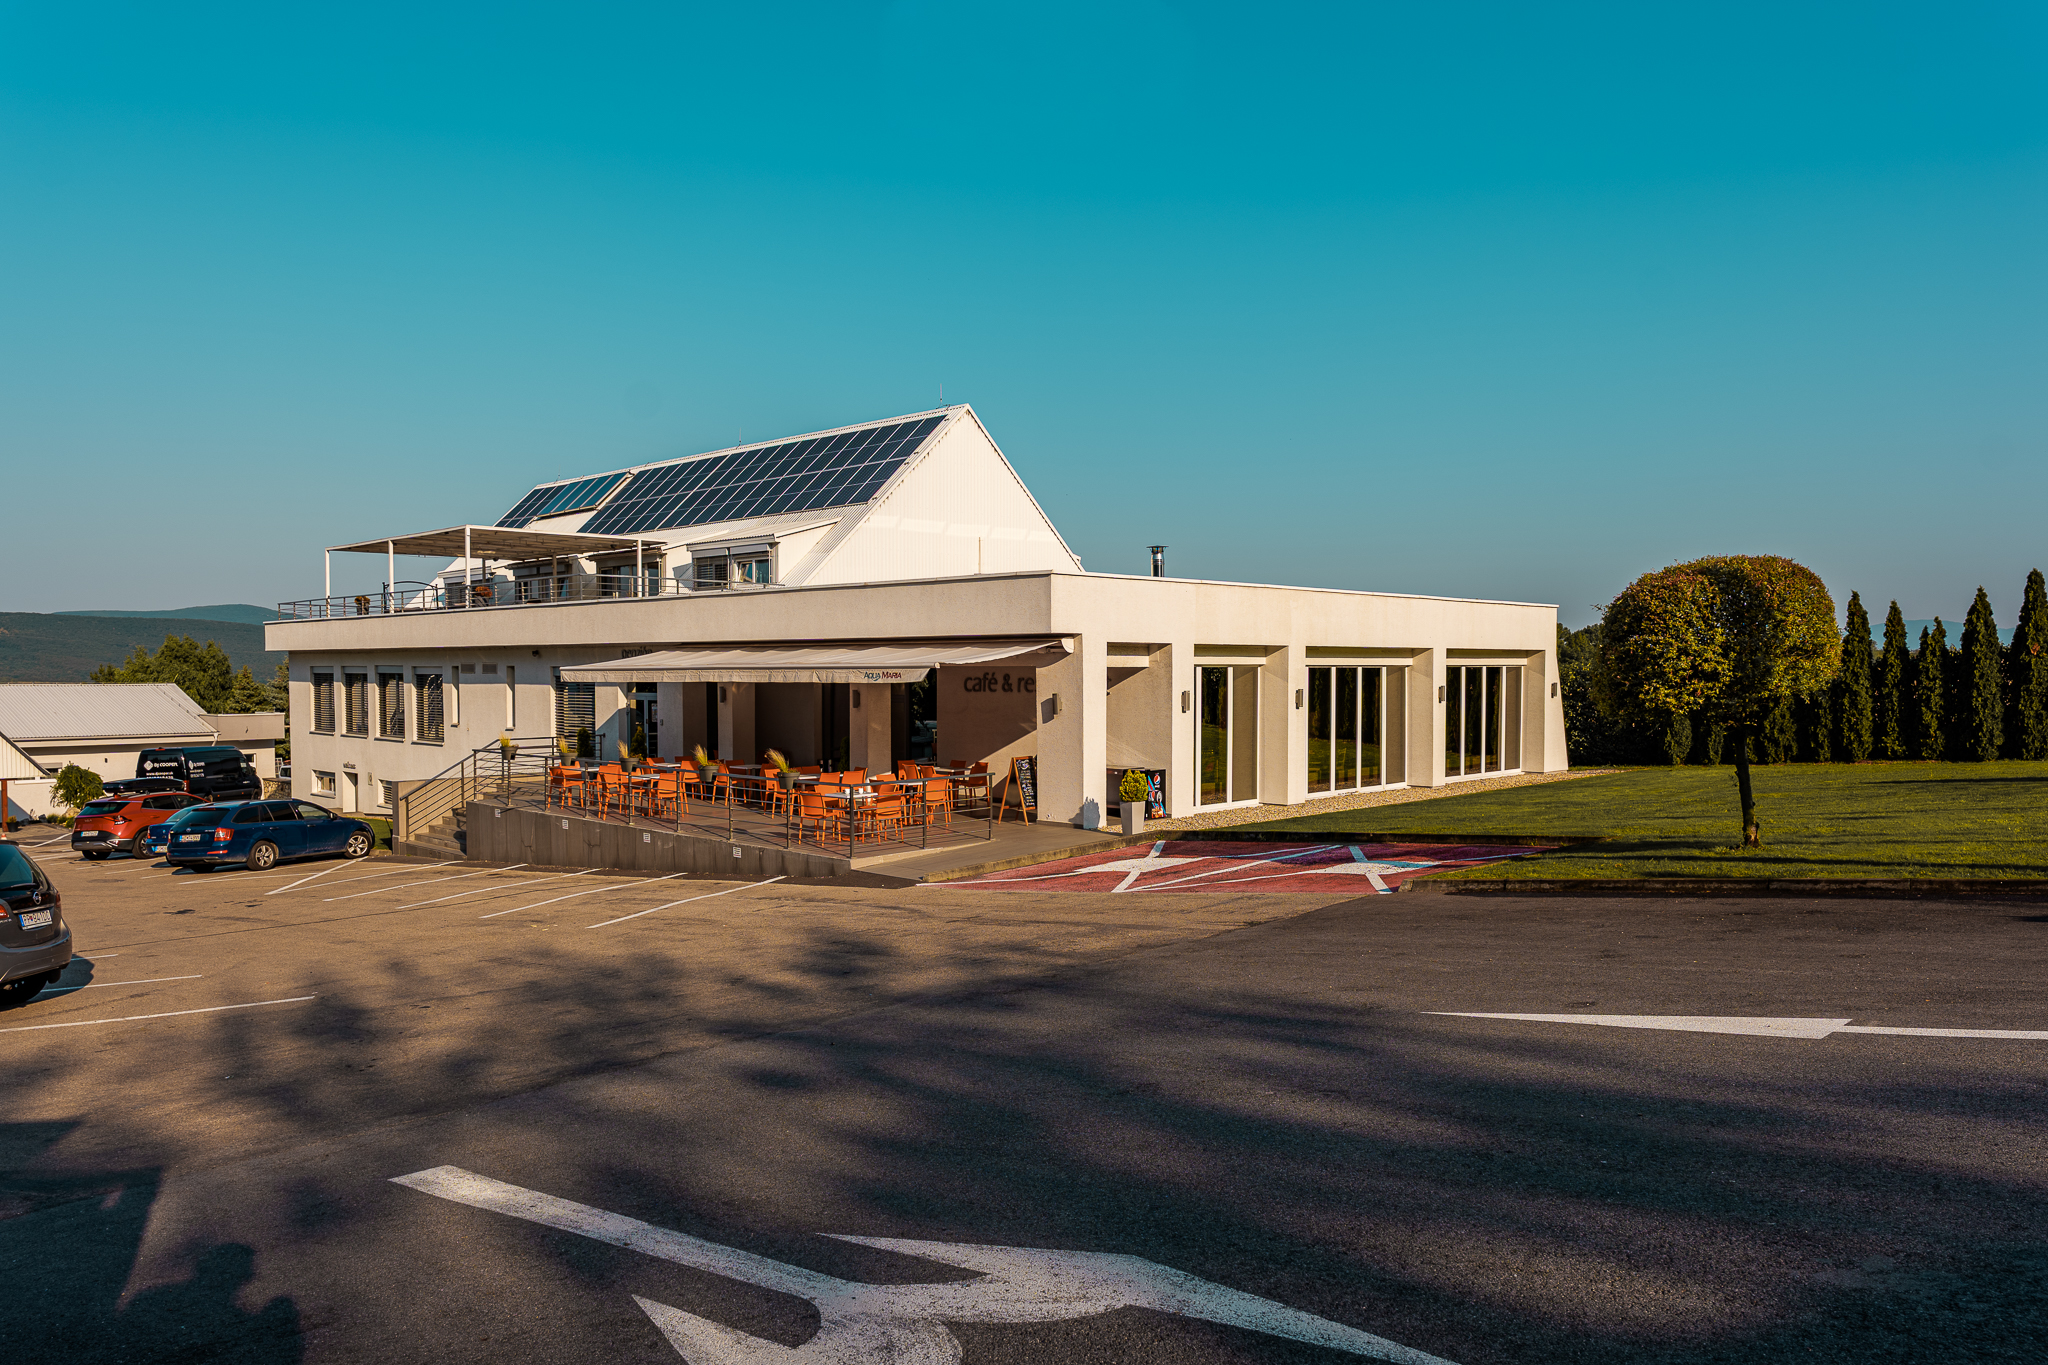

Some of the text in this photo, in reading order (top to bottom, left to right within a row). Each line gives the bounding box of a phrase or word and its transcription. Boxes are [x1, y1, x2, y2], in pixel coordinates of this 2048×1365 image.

[863, 671, 902, 681] AQUA MARIA
[963, 672, 1036, 693] café & re
